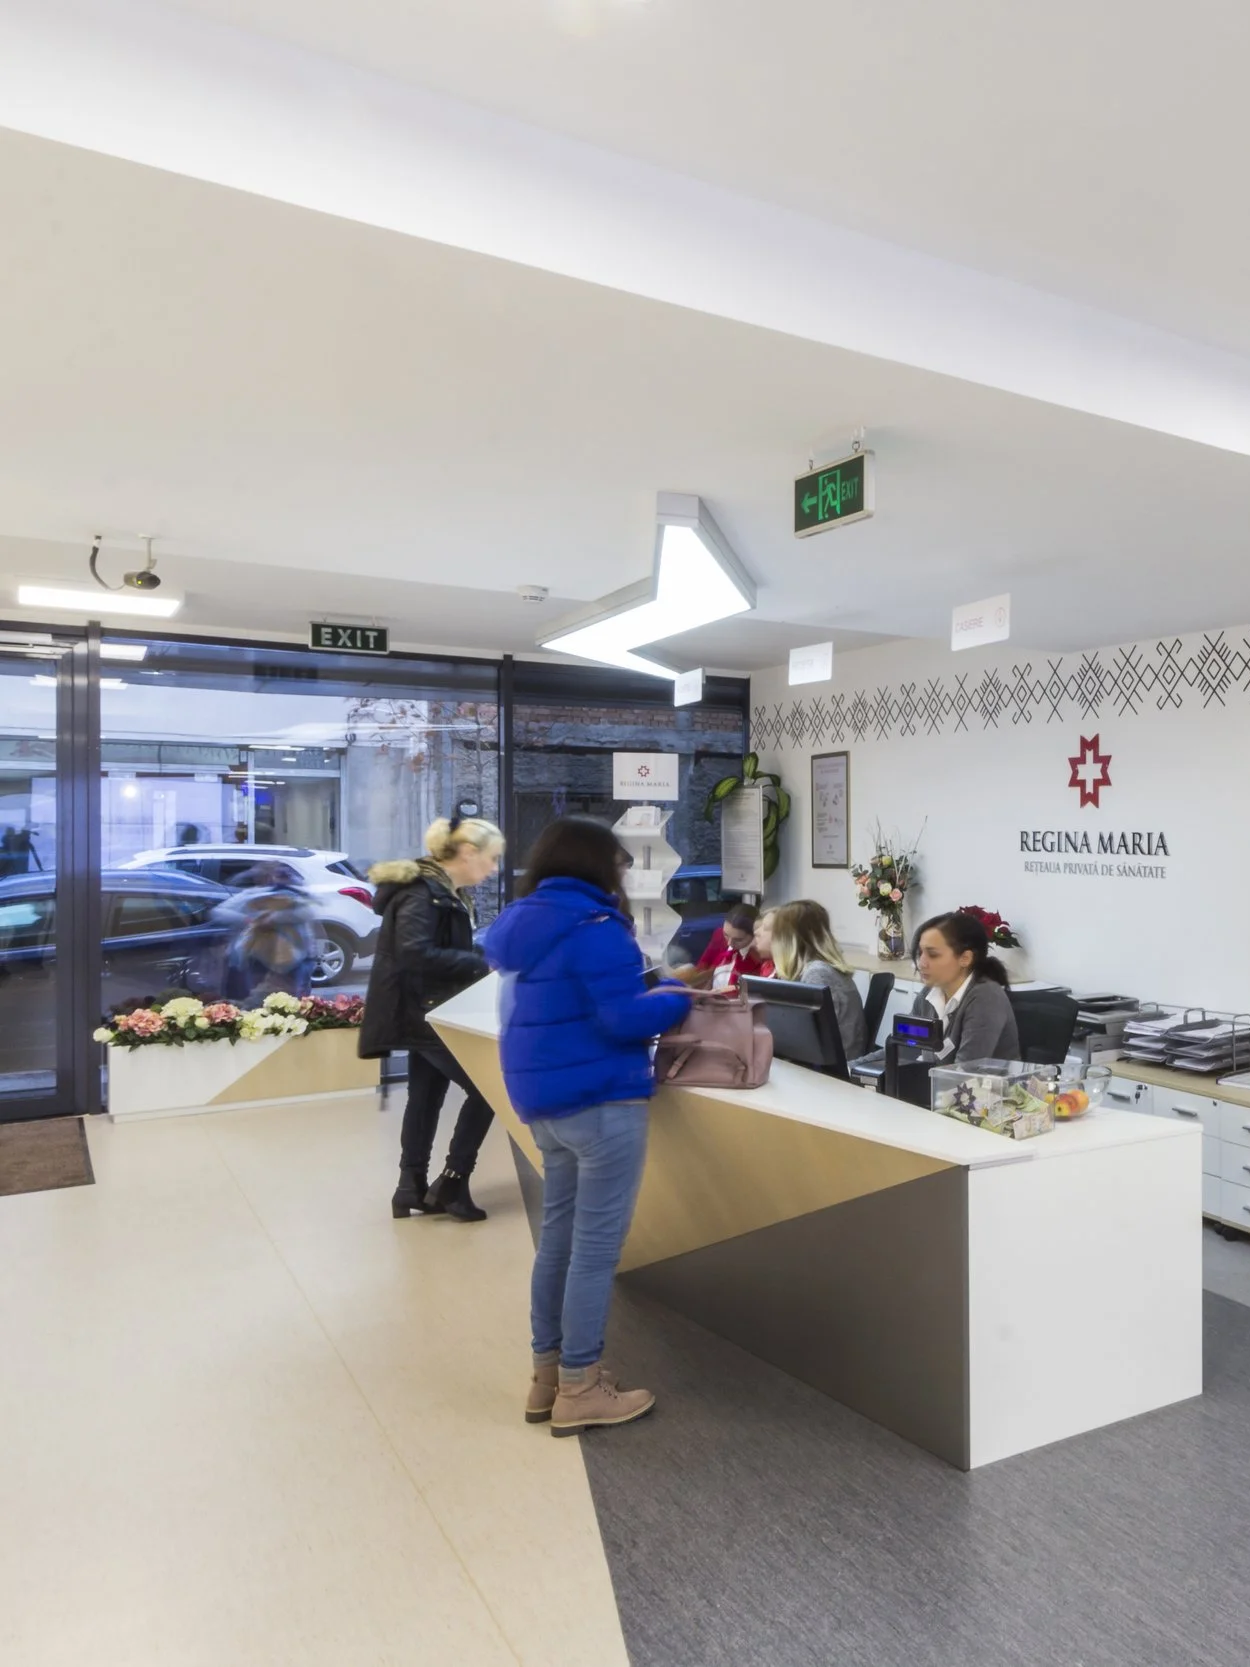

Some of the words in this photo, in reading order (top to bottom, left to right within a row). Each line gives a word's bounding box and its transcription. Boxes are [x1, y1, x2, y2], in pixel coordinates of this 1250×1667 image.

[841, 476, 859, 502] EXIT
[320, 627, 379, 649] EXIT
[1020, 830, 1092, 854] REGINA
[1097, 831, 1170, 856] MARIA
[1101, 864, 1114, 877] DE
